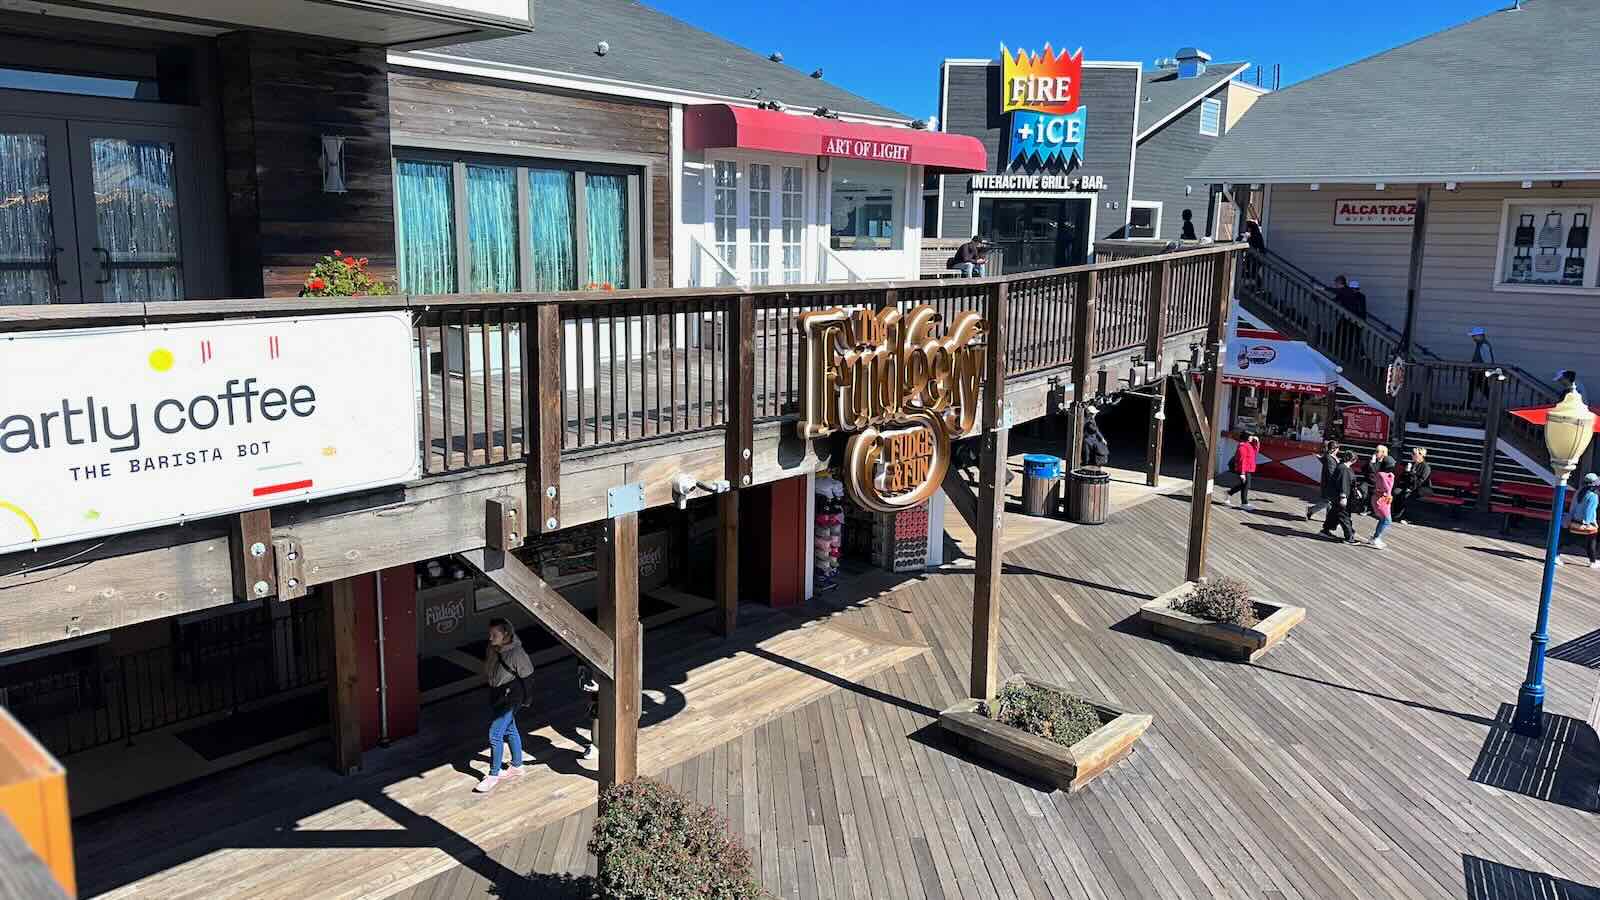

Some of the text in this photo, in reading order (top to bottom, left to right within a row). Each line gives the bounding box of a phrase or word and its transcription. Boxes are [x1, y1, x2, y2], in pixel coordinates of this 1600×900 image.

[827, 138, 910, 160] ART OF LIGHT
[971, 175, 1039, 189] INTERACTIVE
[1041, 175, 1070, 189] GRILL
[1340, 203, 1416, 215] ALCATRAZ
[154, 378, 316, 434] coffee
[69, 441, 272, 481] THE BARISTA BOT
[891, 428, 934, 465] FUDGE
[904, 456, 929, 488] FUN
